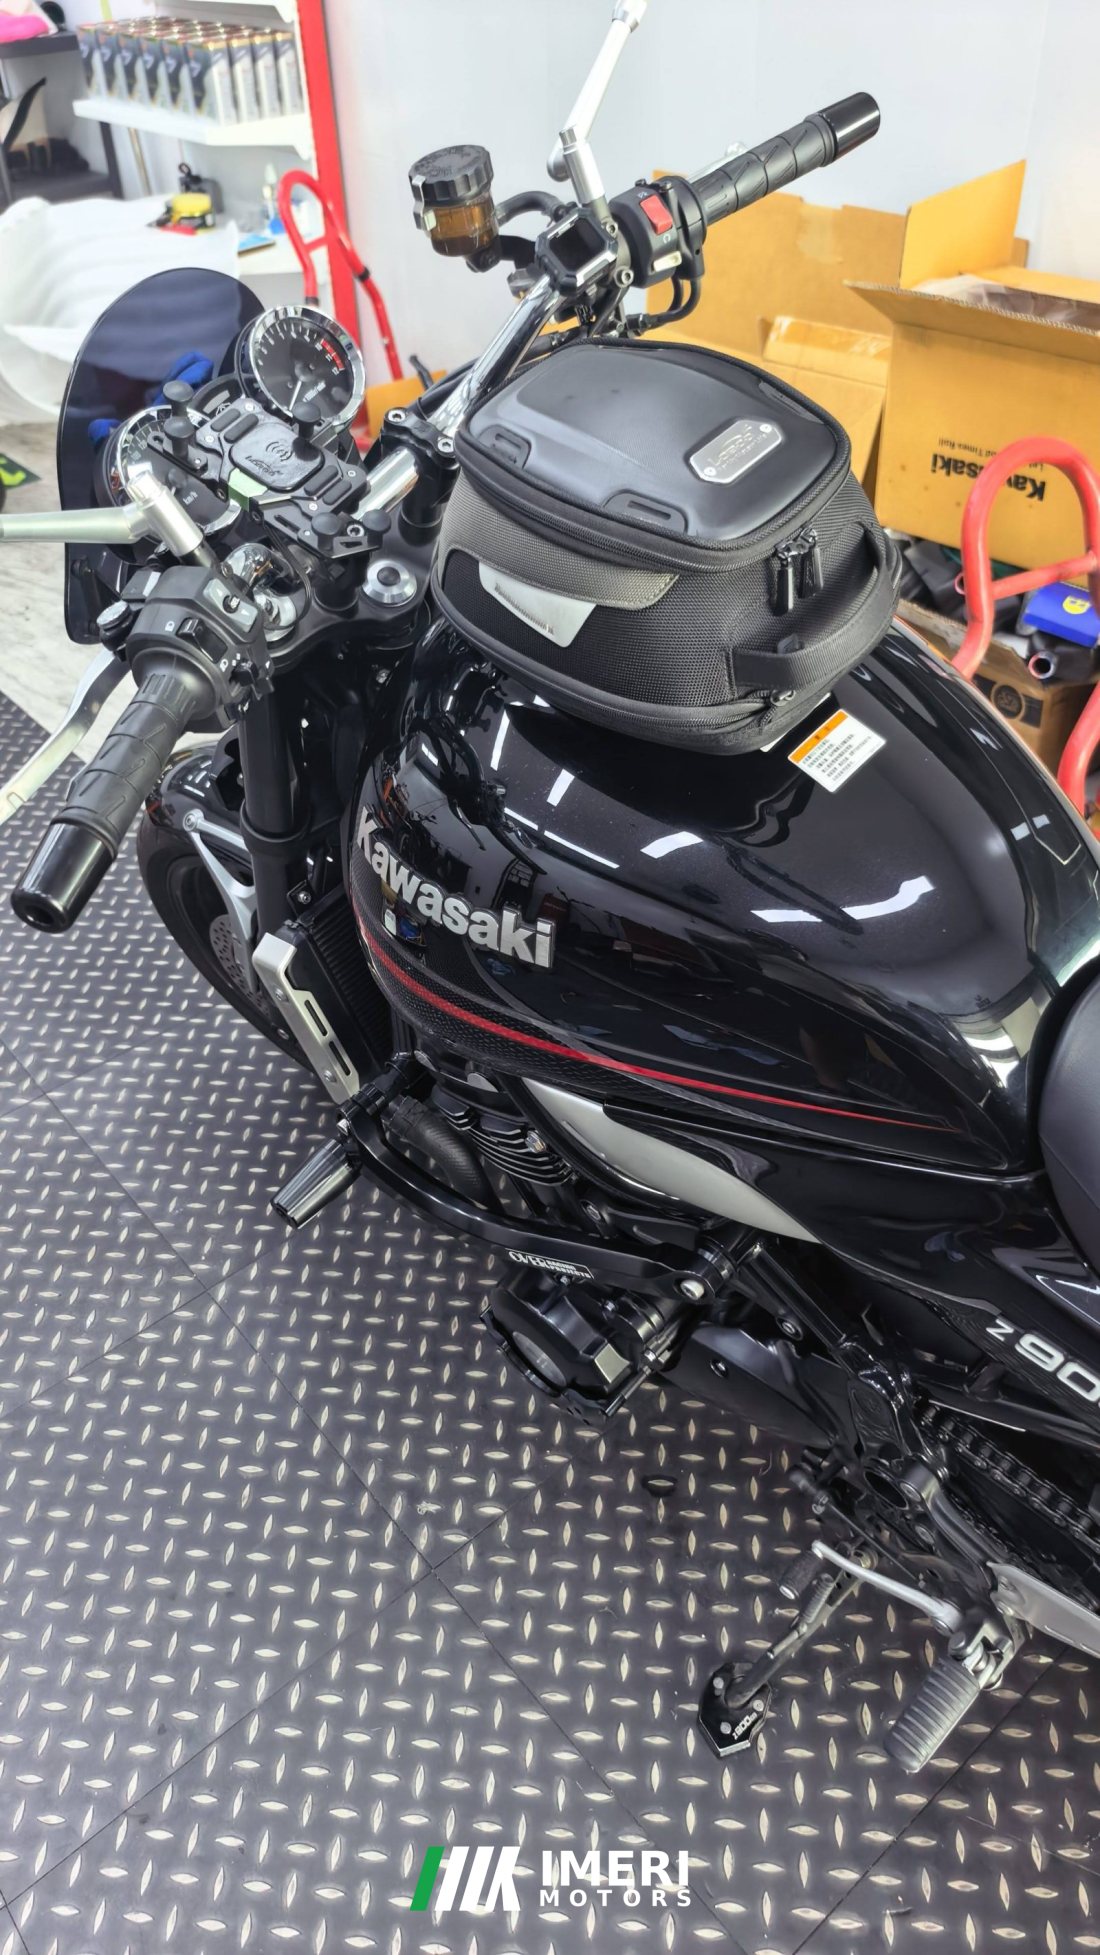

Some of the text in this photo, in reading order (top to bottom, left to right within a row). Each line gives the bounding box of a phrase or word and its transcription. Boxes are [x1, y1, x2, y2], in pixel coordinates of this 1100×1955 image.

[182, 491, 198, 506] km/h
[931, 453, 1046, 502] Kasaki
[357, 806, 553, 969] Kawasaki
[1014, 1333, 1100, 1408] 90
